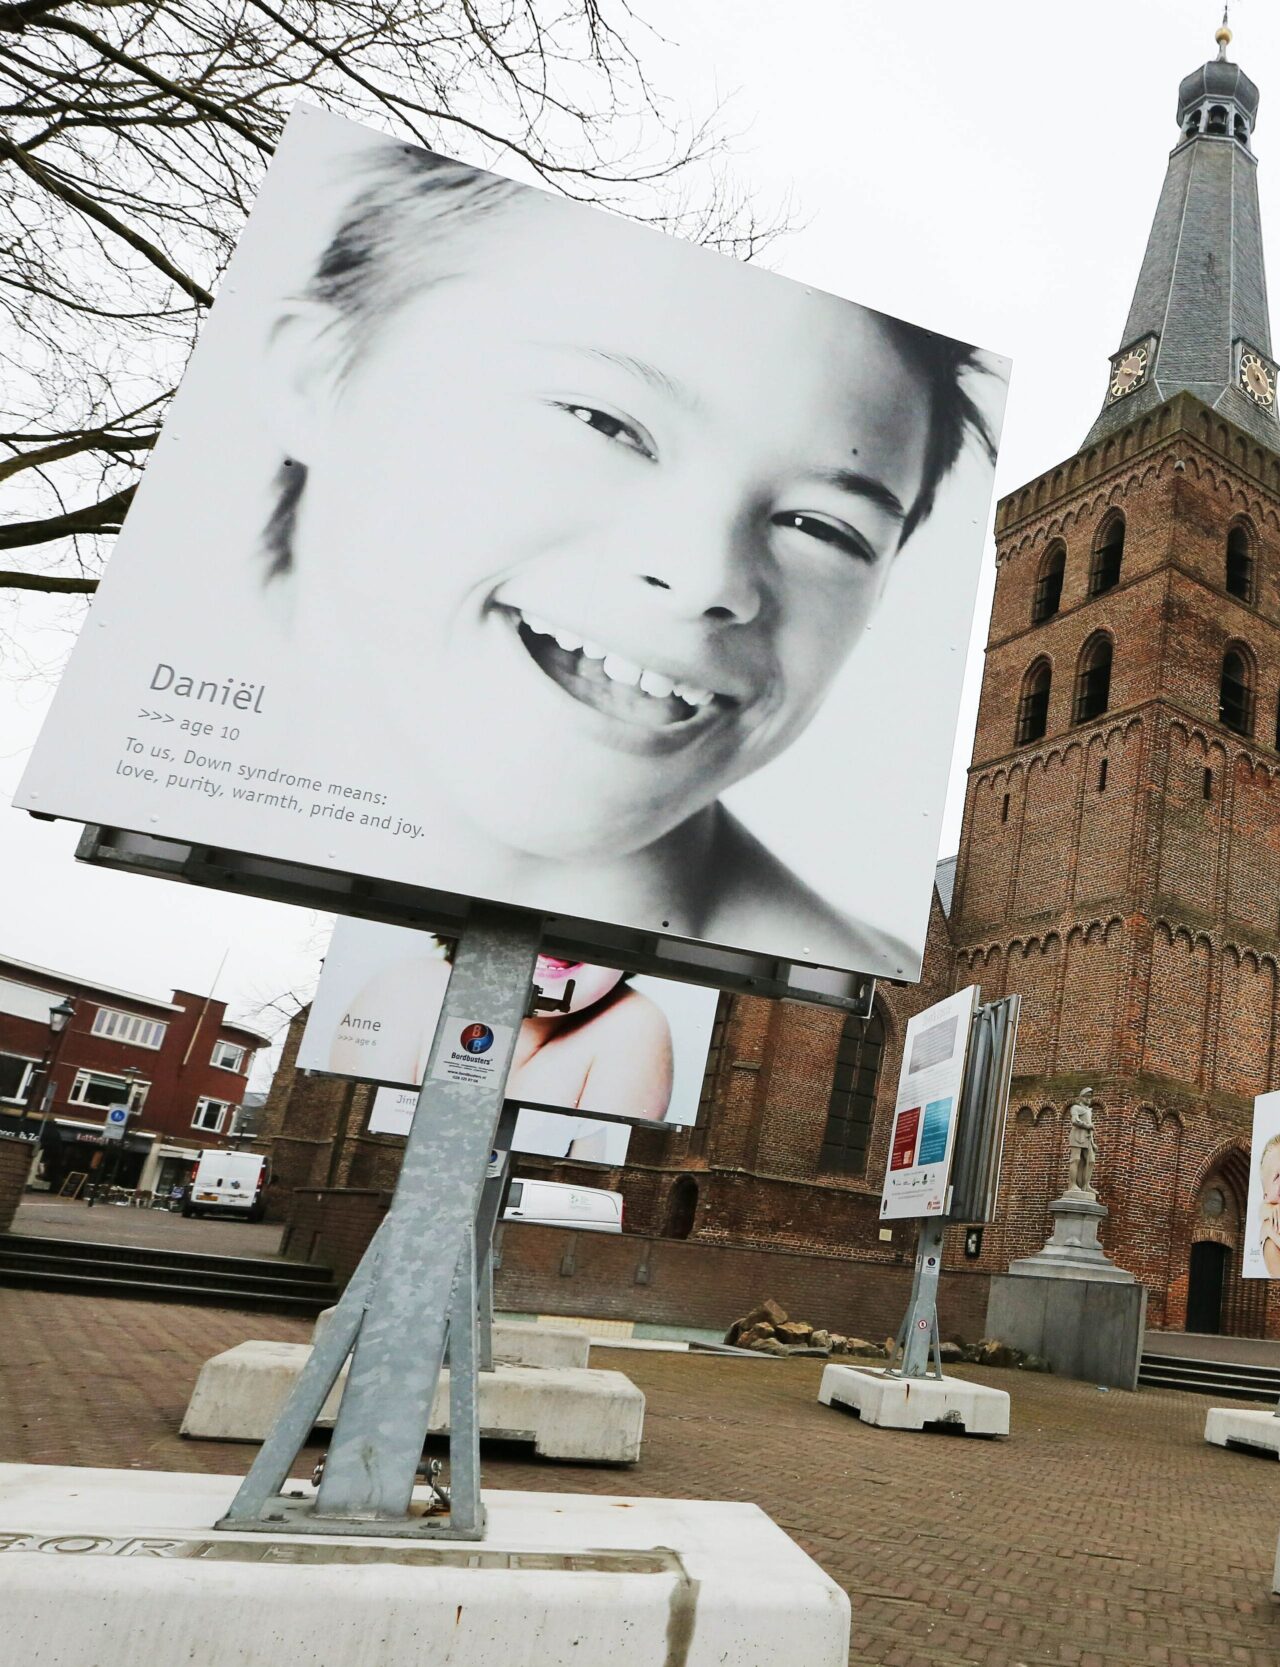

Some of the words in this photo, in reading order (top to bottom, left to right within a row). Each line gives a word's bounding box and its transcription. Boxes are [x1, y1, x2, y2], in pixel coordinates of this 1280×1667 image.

[150, 663, 265, 713] Daniël
[180, 719, 214, 736] age
[220, 726, 240, 740] 10
[126, 737, 144, 754] To
[150, 746, 175, 762] us,
[184, 750, 232, 772] Down
[238, 764, 322, 792] syndrome
[328, 783, 387, 805] means:
[116, 760, 158, 784] love,
[166, 774, 224, 798] purity,
[232, 787, 303, 813] warmth,
[310, 803, 355, 822] pride
[359, 816, 392, 829] and
[393, 818, 425, 839] joy.
[340, 1013, 381, 1031] Anne
[355, 1038, 370, 1046] age
